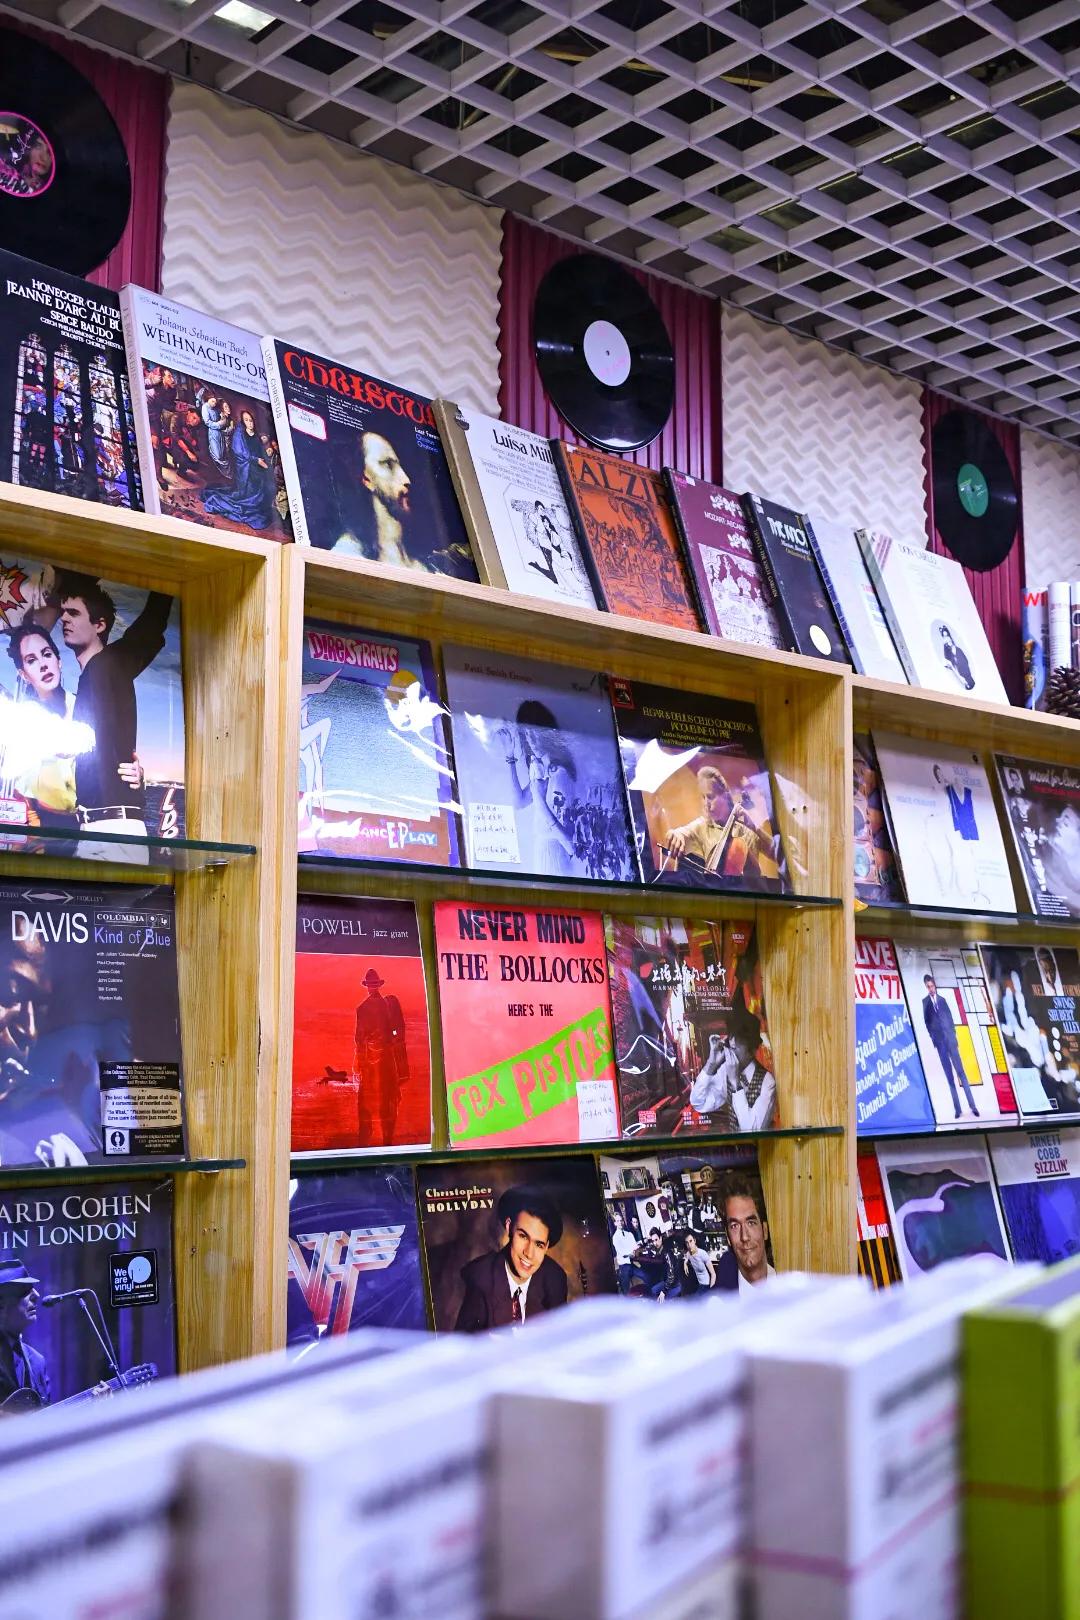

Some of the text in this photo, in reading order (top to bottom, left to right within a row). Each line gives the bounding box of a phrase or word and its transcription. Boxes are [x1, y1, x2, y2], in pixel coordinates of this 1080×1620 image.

[7, 280, 106, 326] JEANNE D'ARC AU
[32, 279, 84, 307] HONEGGER
[50, 310, 113, 340] SERGE BAUDO
[187, 327, 226, 348] Sebastian
[227, 340, 248, 357] Bach
[492, 429, 528, 456] Luisa
[345, 639, 399, 672] STRAITS
[642, 707, 664, 719] ELGAR
[11, 912, 89, 944] DAVIS
[96, 913, 145, 923] COLUMBIA
[301, 918, 367, 936] POWELL
[457, 909, 586, 945] NEVER MIND
[94, 927, 172, 947] Kind of Blue
[373, 929, 409, 939] jazz giant
[855, 940, 894, 967] LIVE
[441, 953, 605, 983] THE BOLLOCKS
[880, 974, 902, 999] '77
[508, 1004, 554, 1017] HERE'S THE
[876, 1015, 903, 1046] Davis
[877, 1042, 918, 1080] Ray Brown
[858, 1069, 911, 1124] Jimmie Smith
[1030, 1134, 1062, 1149] ARNETT
[1037, 1147, 1061, 1161] COBB
[1035, 1159, 1068, 1175] SIZZLIN'
[62, 1194, 152, 1220] COHEN
[425, 1186, 492, 1203] Christopher
[427, 1199, 494, 1213] HOLLYDAY
[3, 1221, 137, 1250] IN LONDON
[113, 1268, 127, 1277] We
